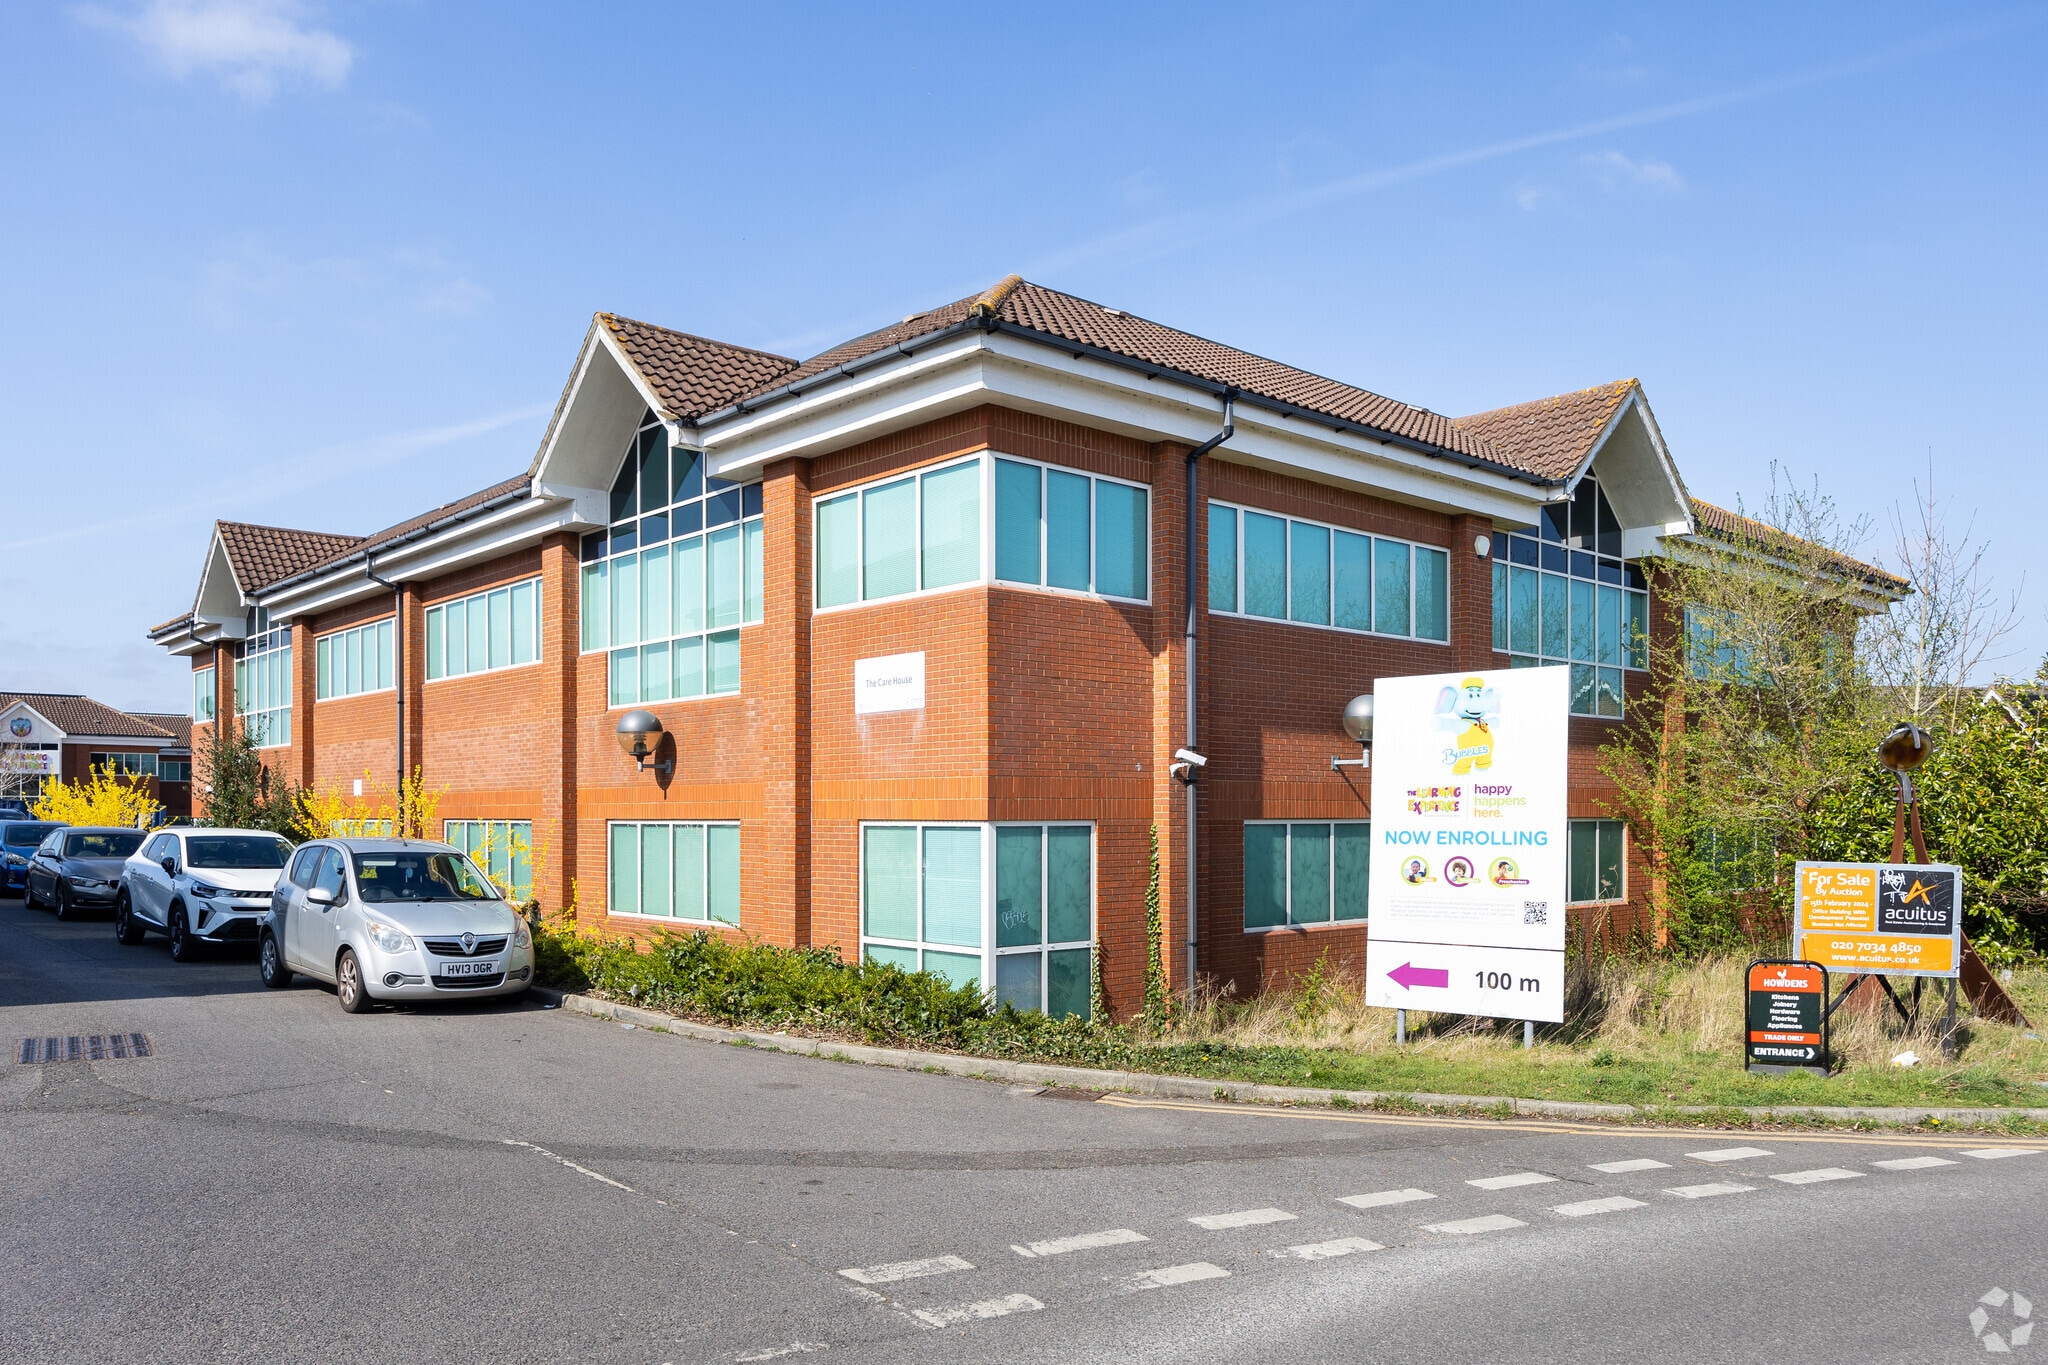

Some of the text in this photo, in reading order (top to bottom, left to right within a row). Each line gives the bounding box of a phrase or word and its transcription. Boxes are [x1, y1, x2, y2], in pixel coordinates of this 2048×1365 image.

[866, 676, 913, 688] The Care House
[1417, 786, 1461, 798] LEARNING
[1474, 784, 1512, 795] happy
[1408, 799, 1460, 815] EXPERIENCE
[1474, 796, 1526, 807] happens
[1474, 808, 1503, 818] here.
[1385, 831, 1548, 846] NOW ENROLLING
[1809, 872, 1870, 886] For Sale
[1815, 887, 1863, 896] By Auction
[1824, 900, 1851, 908] February
[1885, 906, 1947, 921] acuitus
[1831, 941, 1922, 955] 020 7034 4850
[1831, 953, 1920, 964] www.acuitus.co.uk
[447, 963, 493, 975] HV13 OGR
[1475, 971, 1540, 992] 100 m
[1763, 979, 1808, 988] HOWDENS
[1771, 1015, 1798, 1023] Flooring
[1767, 1022, 1803, 1030] Appliances
[1754, 1047, 1805, 1057] ENTRANCE
